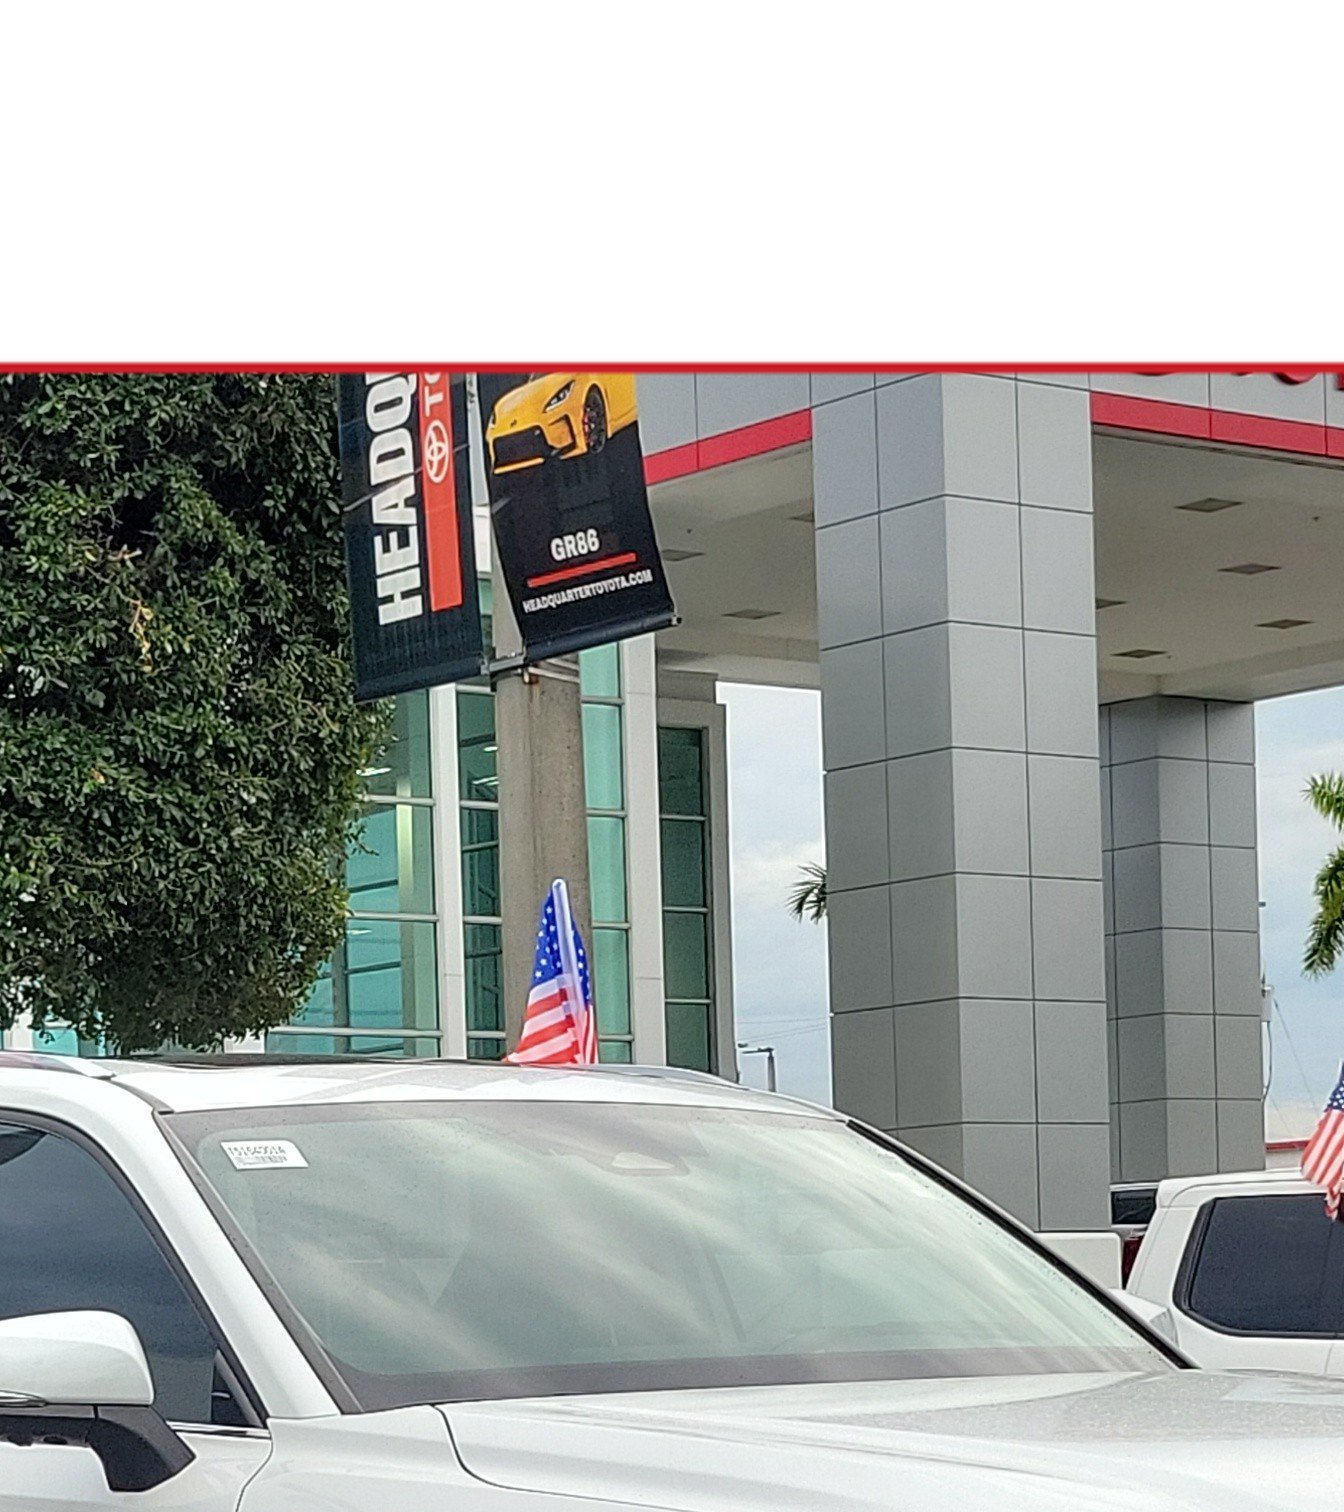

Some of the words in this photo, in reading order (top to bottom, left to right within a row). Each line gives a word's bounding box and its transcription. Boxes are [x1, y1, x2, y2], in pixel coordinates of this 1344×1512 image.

[365, 372, 423, 626] HEADQ
[550, 528, 600, 561] GR86
[522, 569, 653, 613] HEADQUARTERTOYOTA.COM
